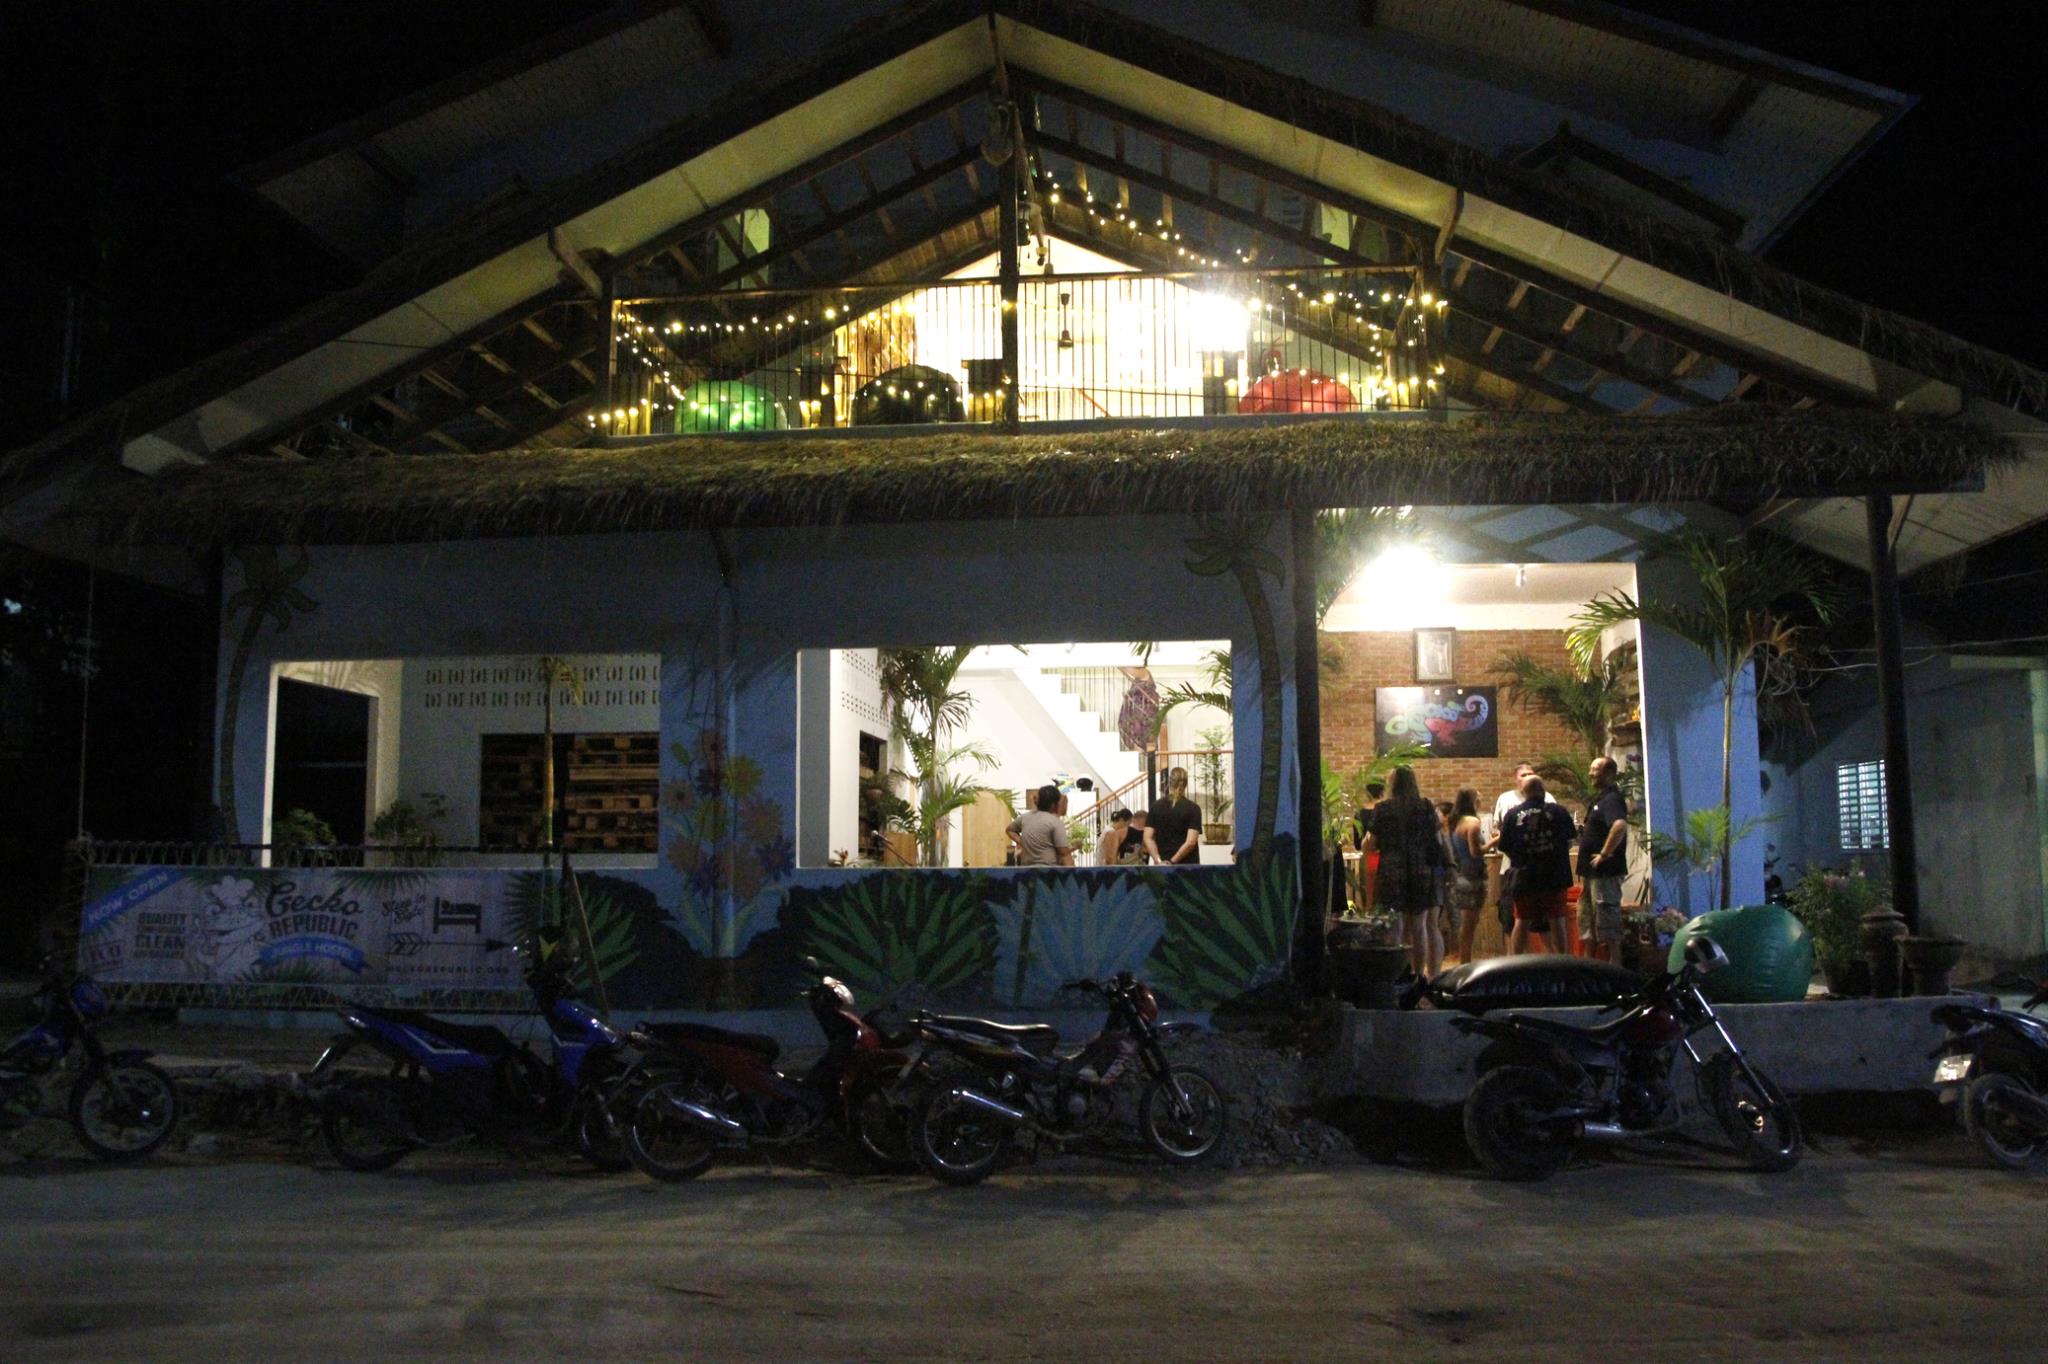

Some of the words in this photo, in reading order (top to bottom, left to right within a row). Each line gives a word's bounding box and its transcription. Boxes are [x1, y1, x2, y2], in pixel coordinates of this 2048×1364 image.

[88, 896, 123, 923] NOW
[129, 871, 169, 900] OPEN
[265, 881, 364, 918] Gecko
[137, 911, 188, 925] QUALITY
[268, 914, 359, 940] REPUBLIC
[135, 934, 186, 949] CLEAN
[314, 943, 354, 961] HOSTEL
